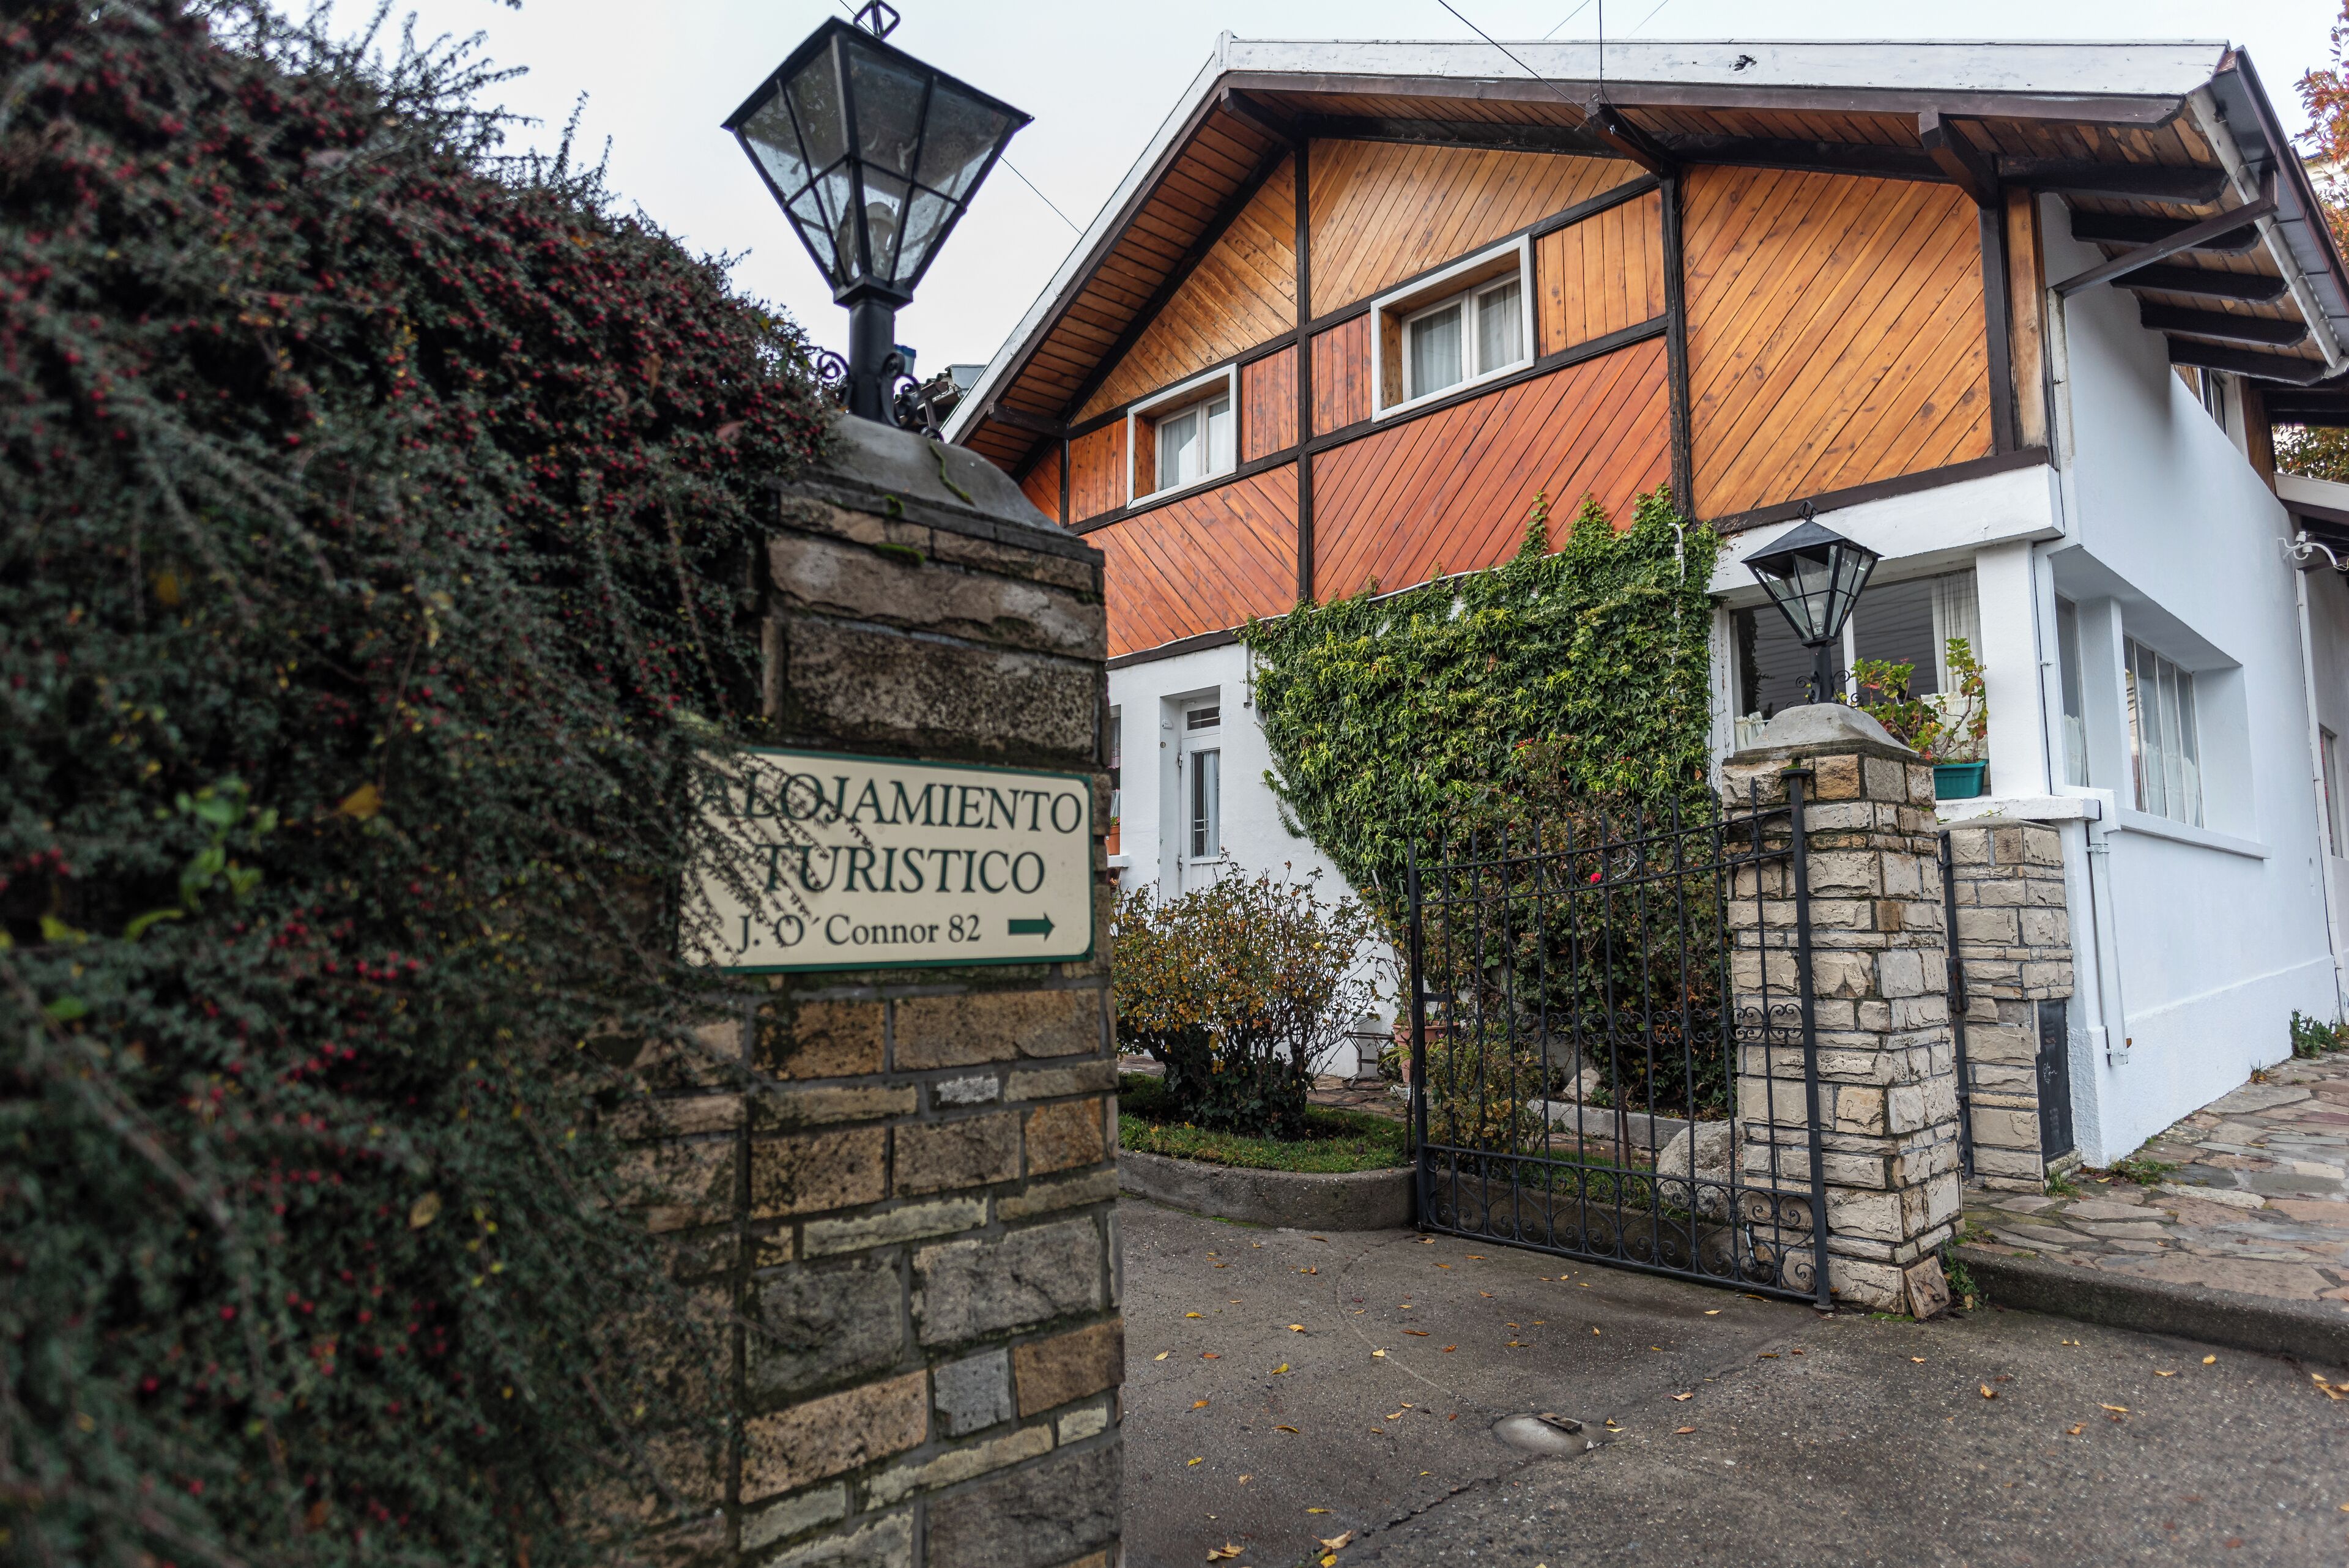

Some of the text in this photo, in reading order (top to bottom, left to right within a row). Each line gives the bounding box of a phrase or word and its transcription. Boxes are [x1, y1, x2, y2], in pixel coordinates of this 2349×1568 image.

[755, 844, 1045, 894] TURISTICO
[737, 915, 760, 954] J.
[948, 914, 981, 943] 82
